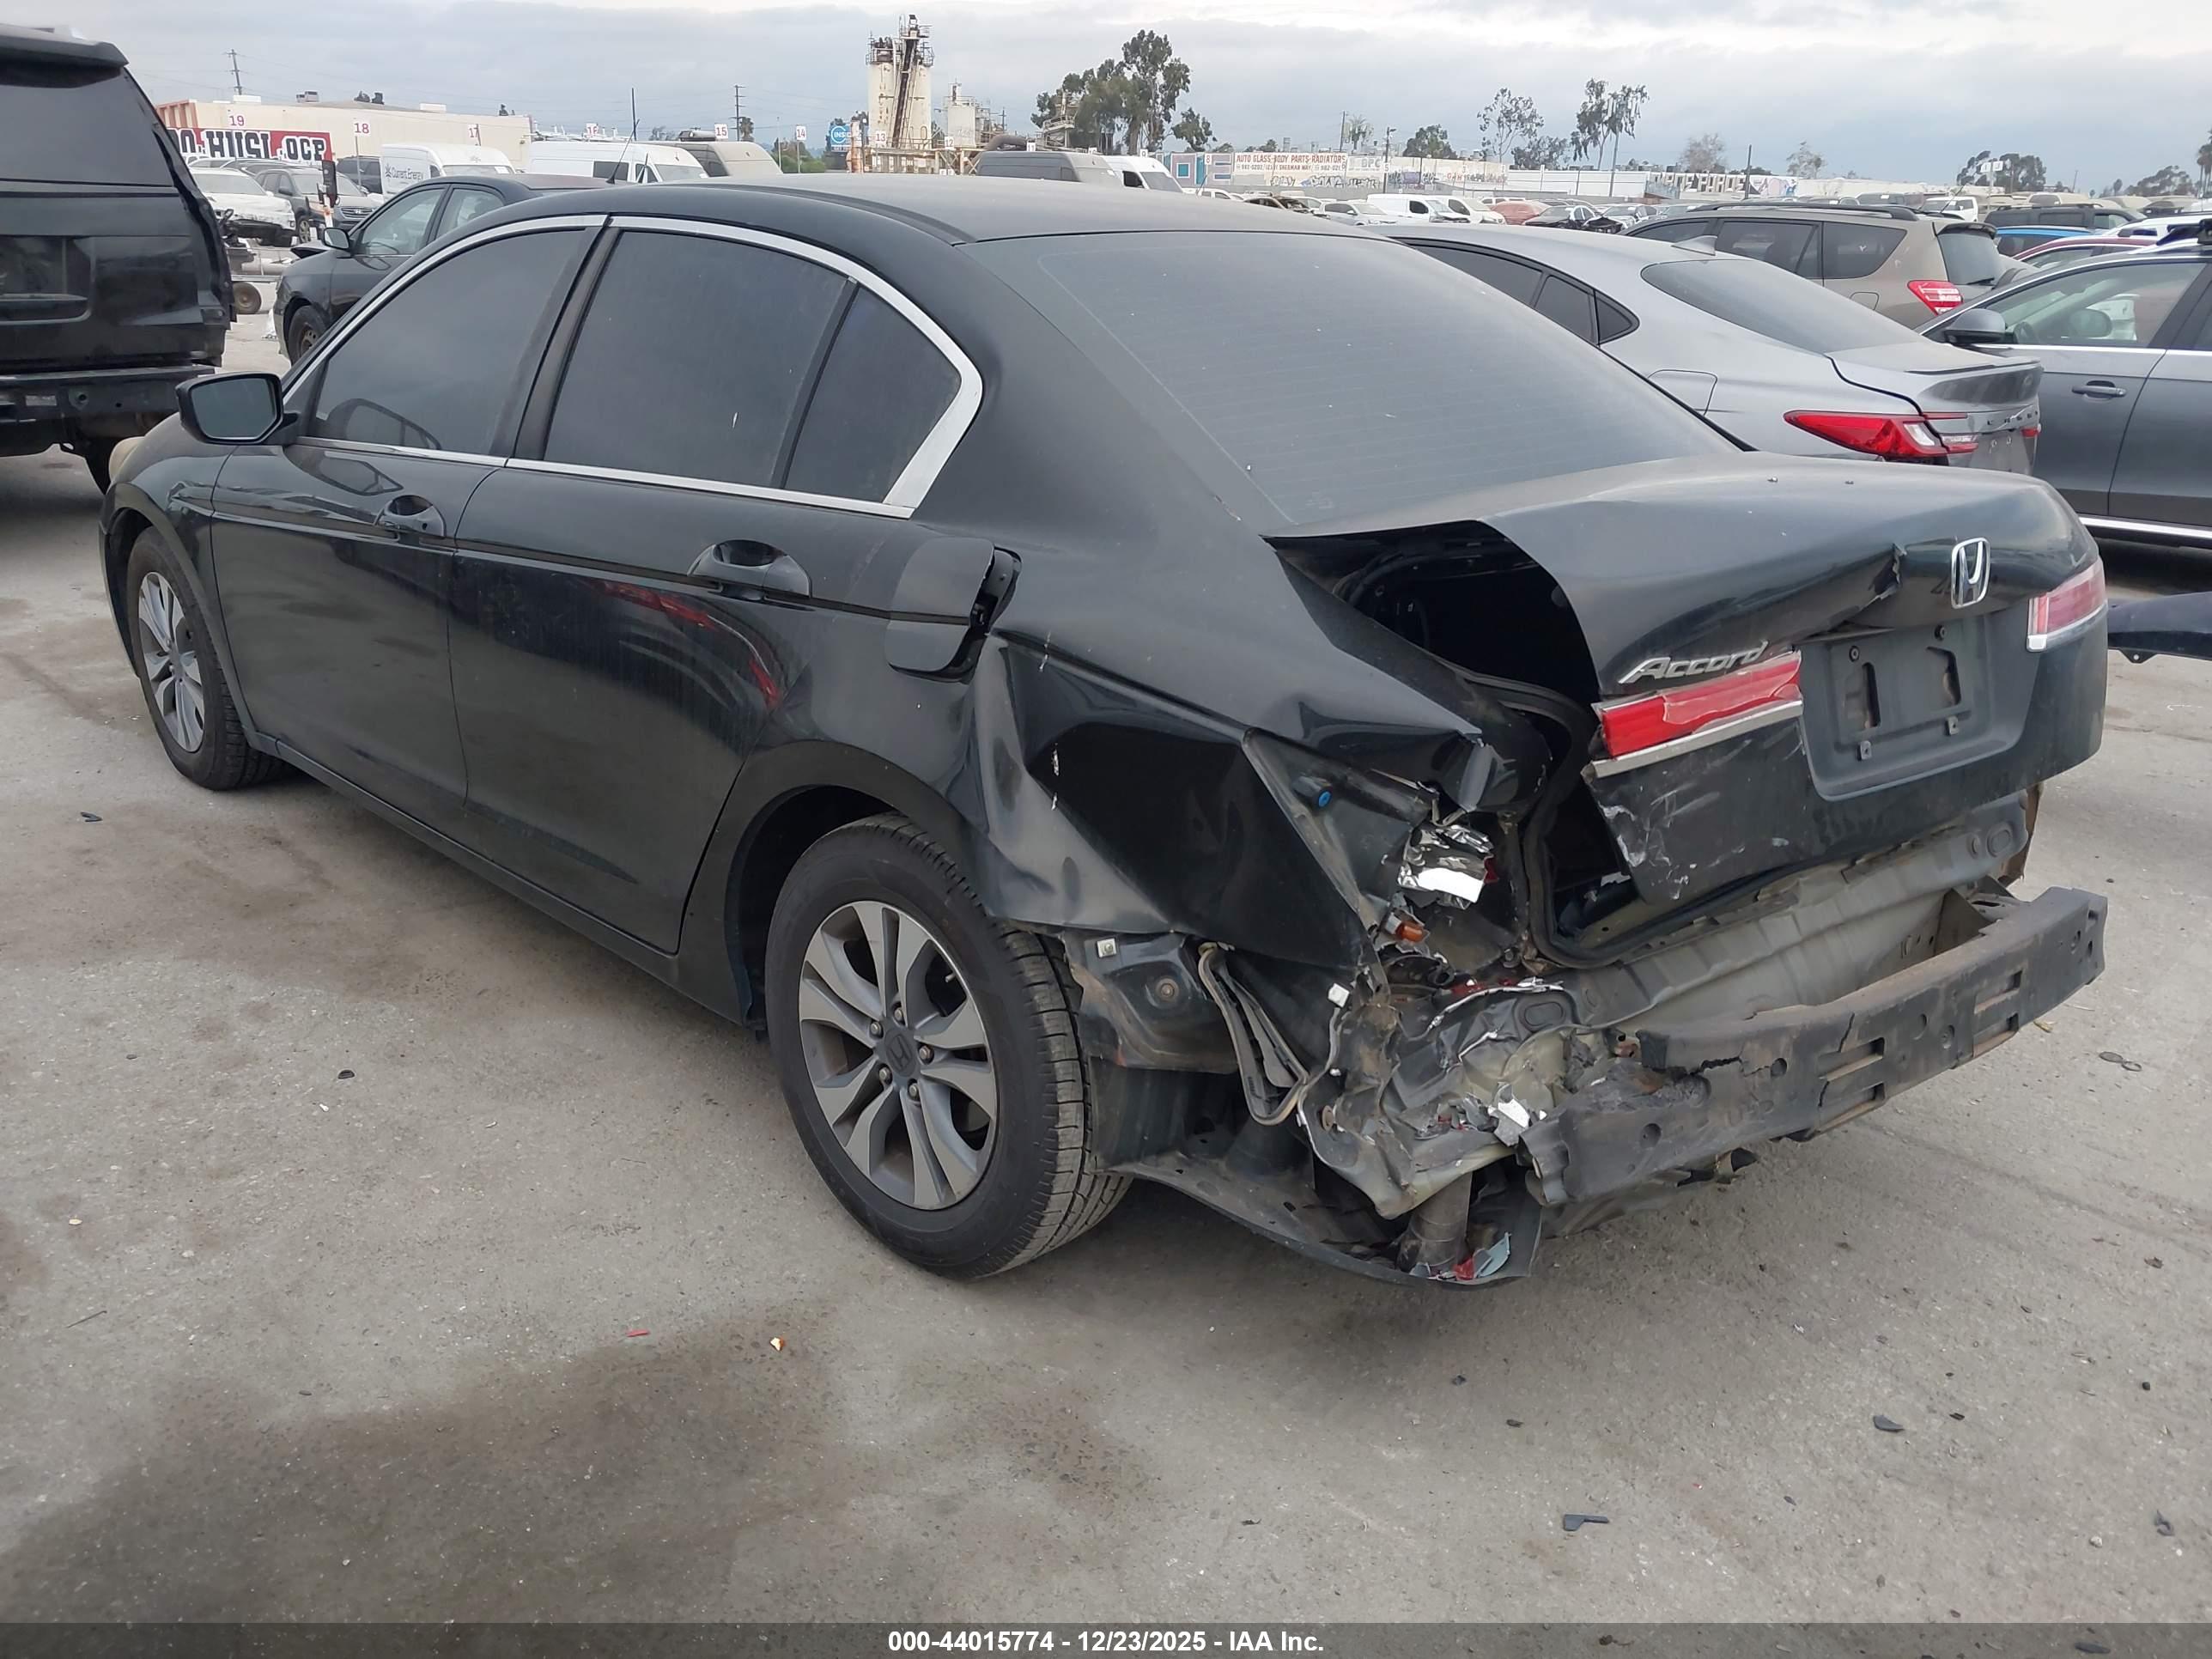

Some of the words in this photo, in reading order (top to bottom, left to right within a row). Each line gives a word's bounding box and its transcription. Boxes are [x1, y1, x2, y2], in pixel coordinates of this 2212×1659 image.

[228, 115, 245, 126] 19
[354, 123, 369, 134] 18
[717, 126, 727, 137] 15
[796, 130, 805, 138] 14
[876, 133, 886, 142] 13
[1237, 155, 1251, 163] AUTO
[1618, 641, 1769, 684] Accord
